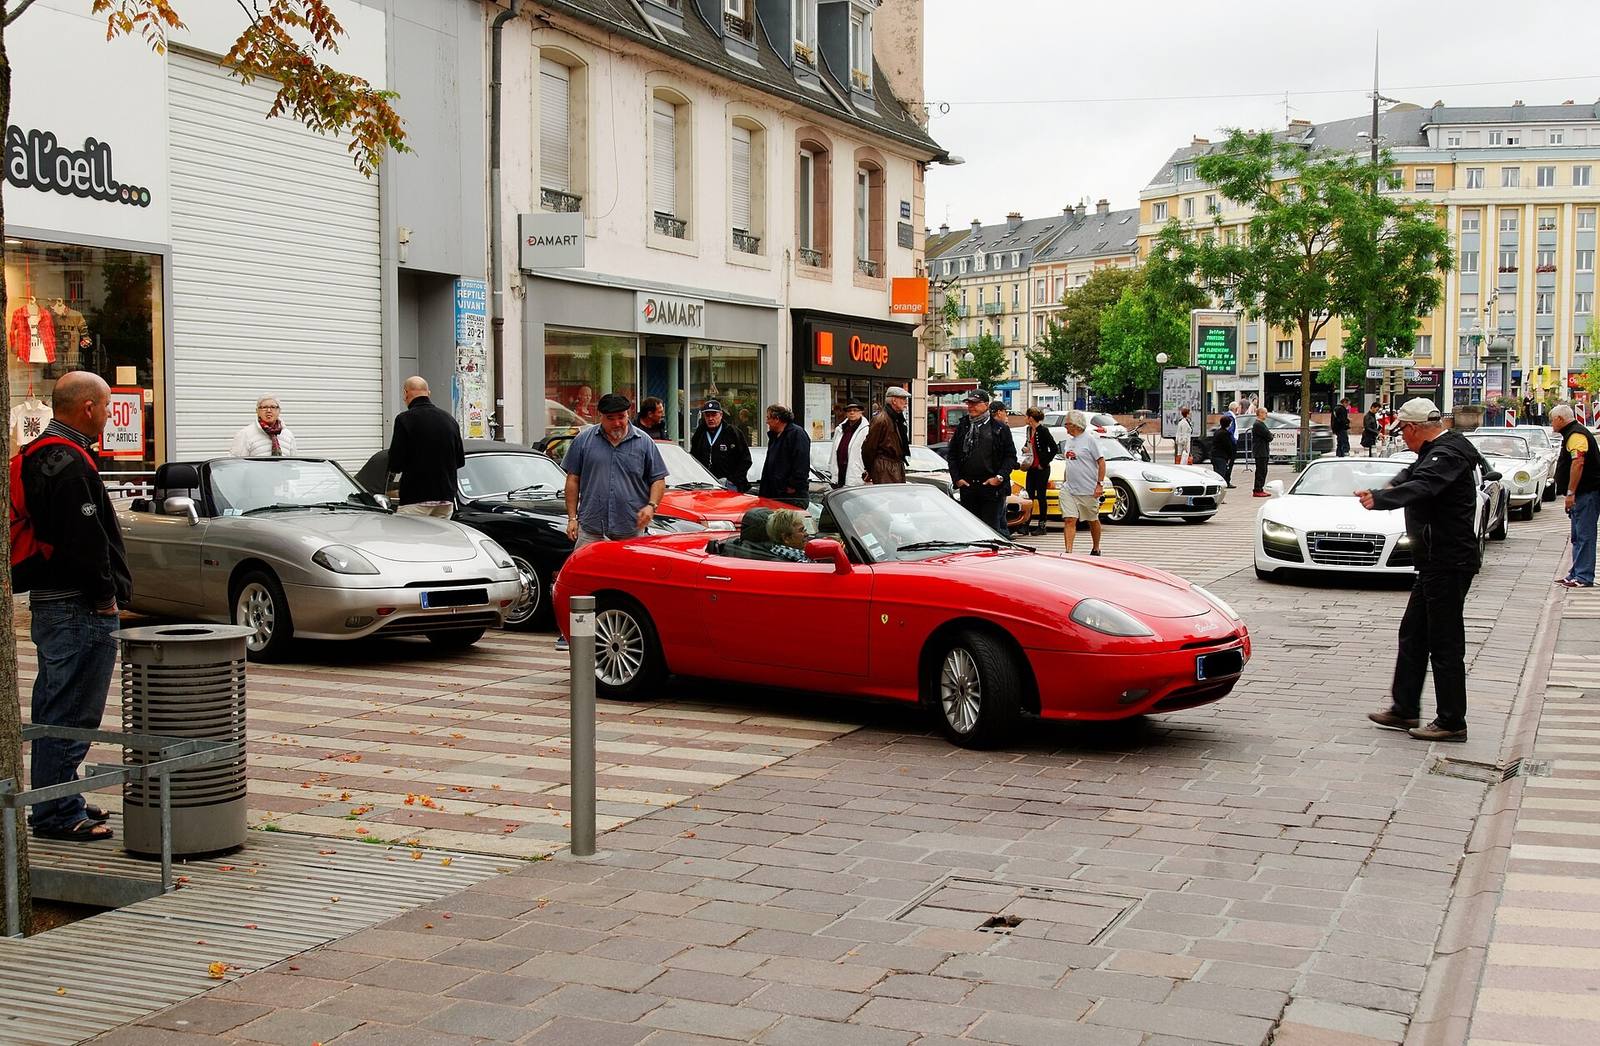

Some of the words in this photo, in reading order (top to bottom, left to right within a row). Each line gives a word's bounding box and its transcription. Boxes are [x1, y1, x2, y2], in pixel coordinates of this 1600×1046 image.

[10, 132, 28, 181] à
[528, 234, 578, 247] DAMART
[457, 300, 485, 311] VIVANT
[893, 303, 922, 312] orange
[643, 298, 703, 328] DAMART
[850, 335, 888, 370] Orange
[116, 433, 138, 442] ARTICLE
